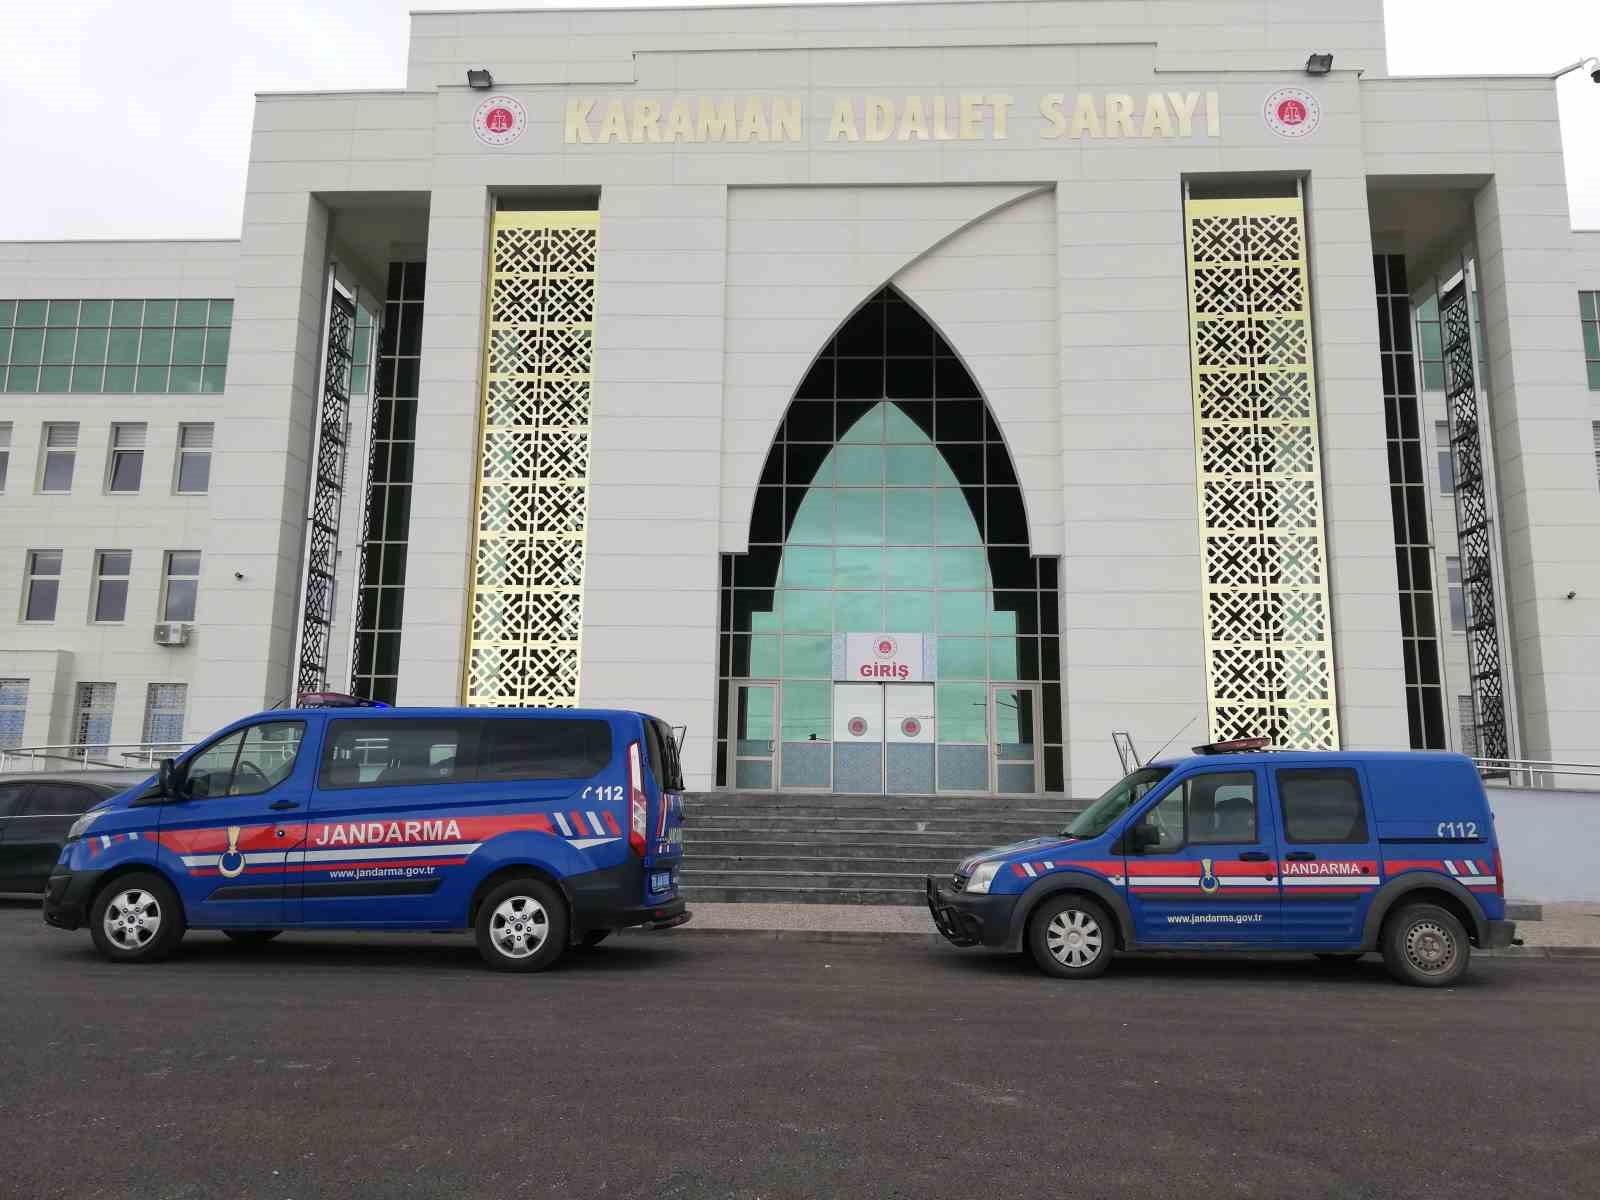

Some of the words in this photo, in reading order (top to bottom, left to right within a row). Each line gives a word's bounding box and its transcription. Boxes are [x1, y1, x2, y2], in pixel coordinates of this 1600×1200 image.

[562, 97, 804, 144] KARAMAN
[828, 94, 1013, 142] ADALET
[1039, 90, 1221, 139] SARAYI
[860, 662, 909, 680] GİRİŞ
[595, 785, 624, 802] 112
[315, 819, 463, 846] JANDARMA
[1446, 822, 1478, 838] 112
[329, 866, 435, 880] www.jandarma.gov.tr
[1282, 862, 1361, 876] JANDARMA
[1167, 913, 1262, 925] www.jandarma.gov.tr
